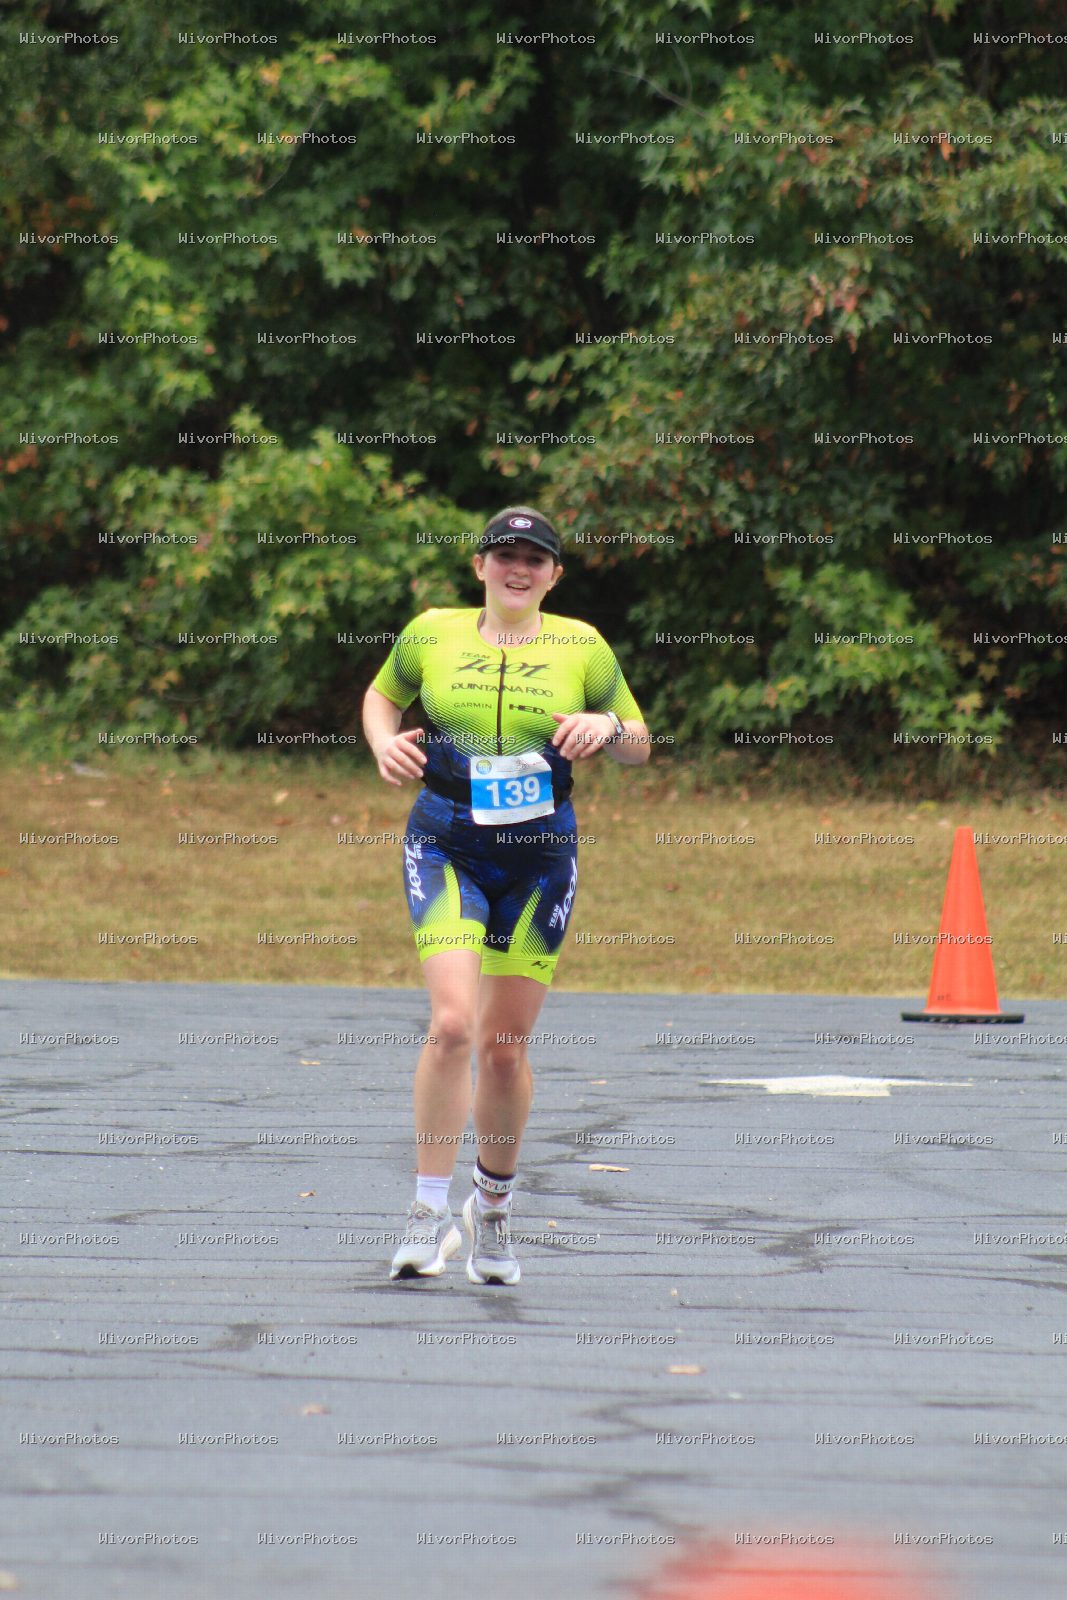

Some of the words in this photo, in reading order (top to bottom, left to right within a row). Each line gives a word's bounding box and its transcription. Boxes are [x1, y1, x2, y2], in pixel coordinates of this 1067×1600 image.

[451, 683, 524, 694] QUINTANA
[526, 687, 554, 698] ROO
[453, 702, 492, 710] GARMIN
[486, 776, 540, 807] 139
